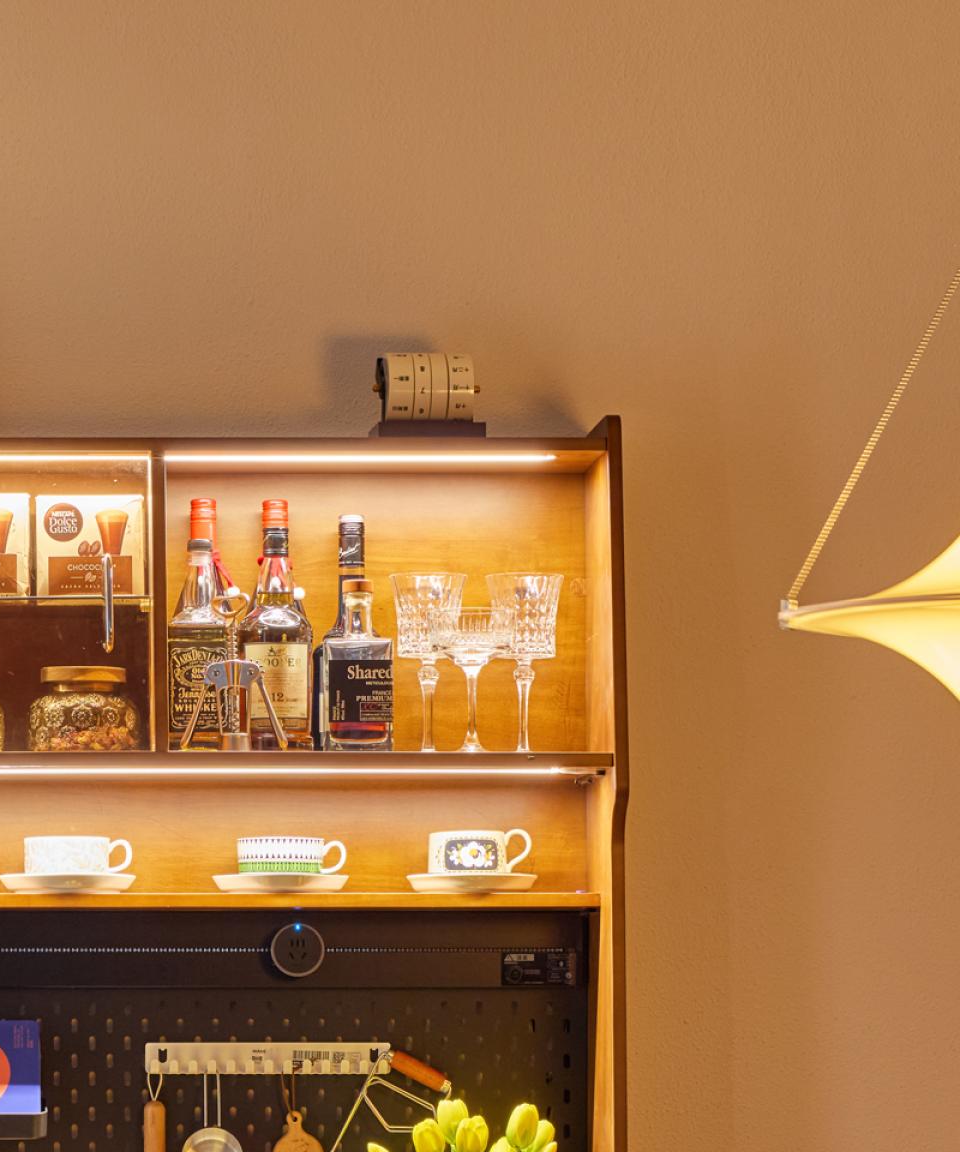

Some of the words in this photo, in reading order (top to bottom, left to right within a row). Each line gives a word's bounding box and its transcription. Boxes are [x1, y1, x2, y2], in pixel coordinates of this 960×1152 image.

[48, 516, 78, 525] Dolce
[48, 525, 78, 534] Gusto
[347, 664, 393, 680] Shared
